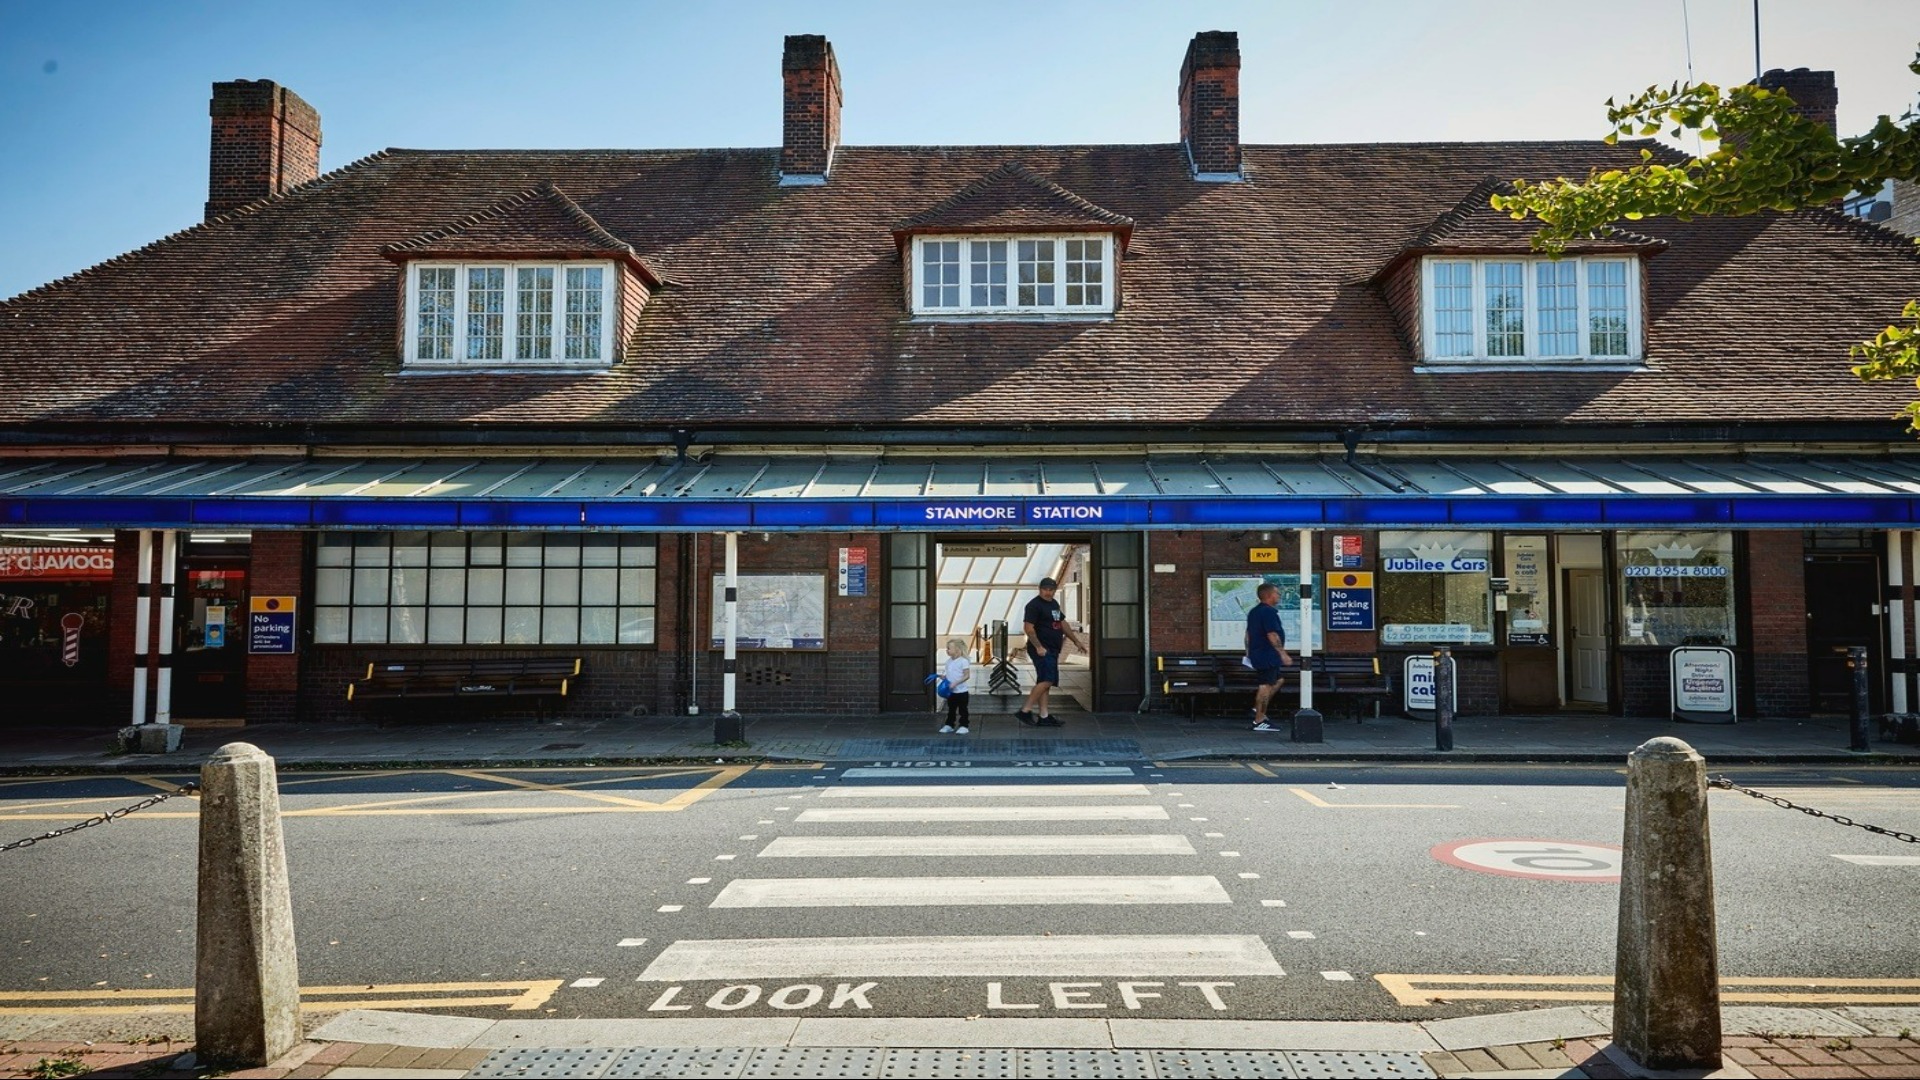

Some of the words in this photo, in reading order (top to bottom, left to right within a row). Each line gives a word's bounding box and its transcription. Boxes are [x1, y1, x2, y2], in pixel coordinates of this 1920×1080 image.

[925, 507, 1016, 519] STANMORE
[1032, 506, 1103, 519] STATION
[1387, 558, 1445, 570] Jubilee
[1451, 559, 1485, 570] Cars
[1625, 567, 1650, 576] 020
[1654, 567, 1688, 576] 8954
[1693, 567, 1728, 576] 8000
[1331, 591, 1347, 599] No
[1332, 600, 1369, 610] parking
[254, 615, 269, 623] No
[254, 624, 290, 633] parking
[863, 760, 972, 768] RIGHT
[1494, 848, 1612, 871] 10
[646, 981, 880, 1013] LOOK
[986, 981, 1236, 1012] LEFT
